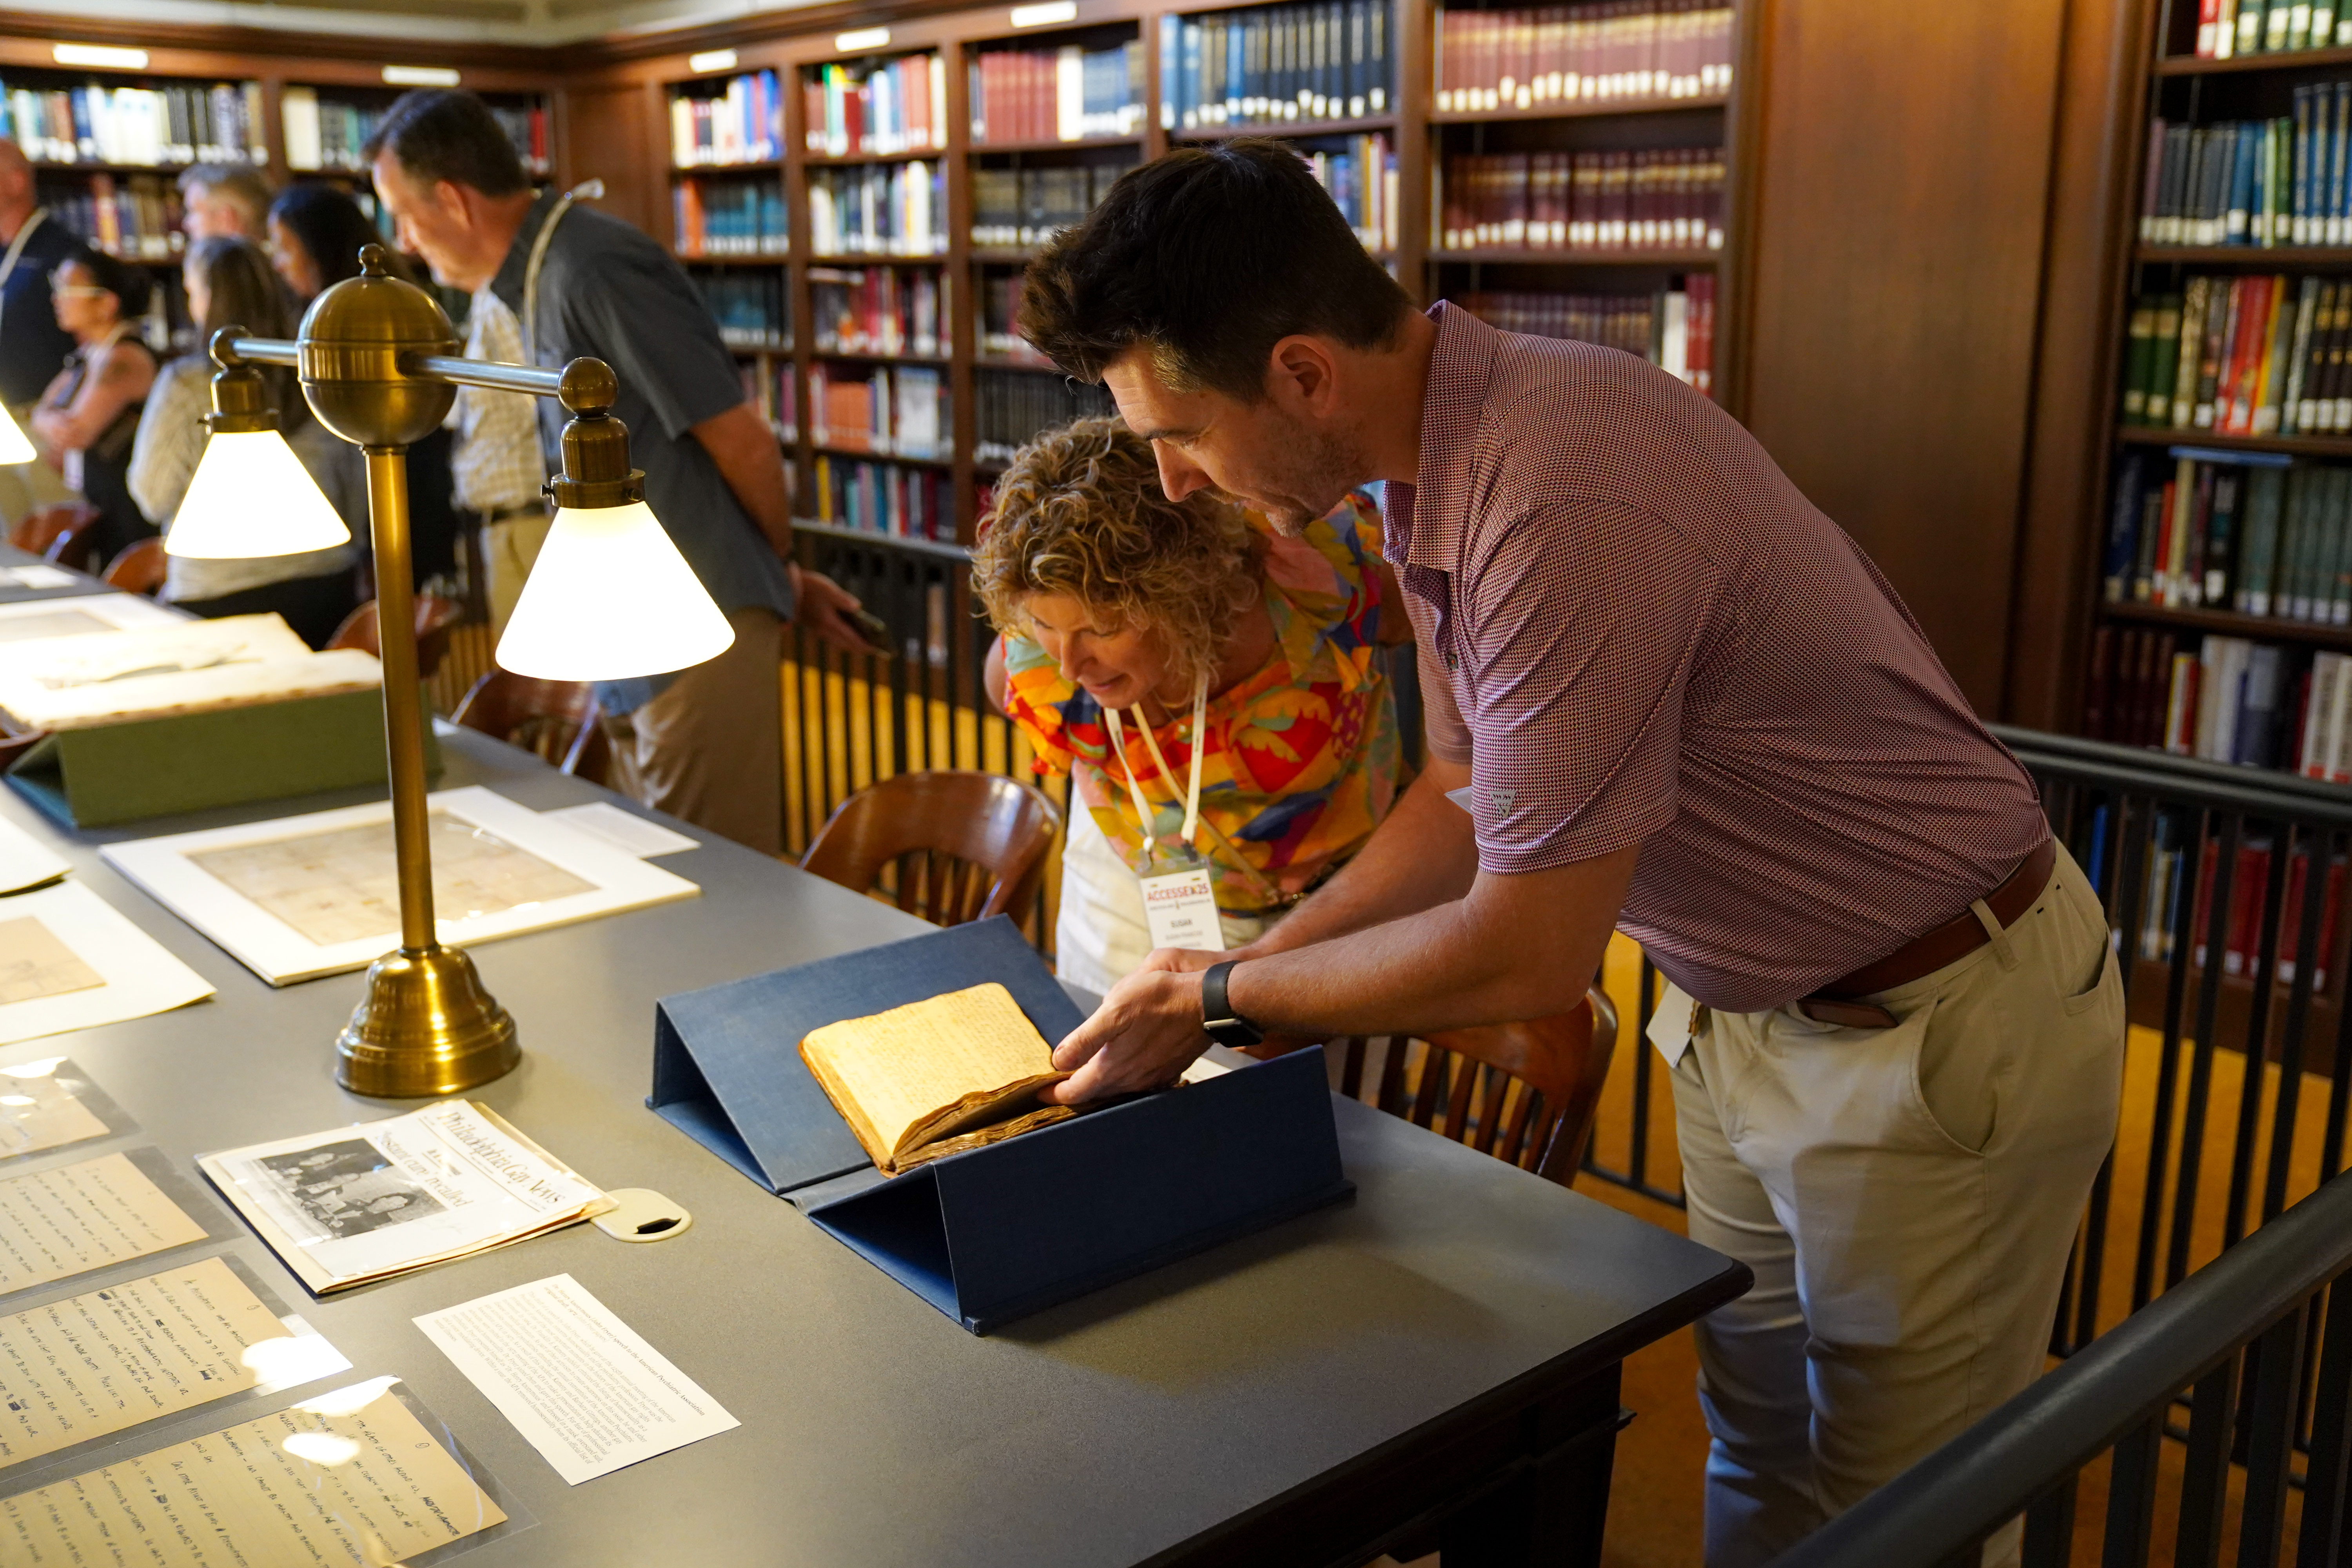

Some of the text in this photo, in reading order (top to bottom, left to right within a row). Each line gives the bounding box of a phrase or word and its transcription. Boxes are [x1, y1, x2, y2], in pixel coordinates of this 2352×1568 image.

[437, 1111, 512, 1169] Philadelphia
[502, 1163, 531, 1187] Gay
[527, 1179, 566, 1203] News
[424, 1177, 474, 1207] recalled
[229, 1330, 250, 1348] HOMOSEXUA
[612, 1337, 630, 1350] speech
[637, 1358, 661, 1376] American
[655, 1375, 683, 1396] Psychiatric
[678, 1394, 707, 1416] Association
[611, 1401, 641, 1425] homosexuality
[636, 1401, 652, 1411] Fryer
[656, 1406, 677, 1423] American
[595, 1408, 617, 1425] American
[611, 1424, 636, 1443] Psychiatric
[635, 1412, 652, 1423] rights
[552, 1427, 566, 1437] from
[565, 1440, 583, 1454] official
[573, 1422, 585, 1431] fear
[583, 1433, 610, 1455] professional
[581, 1420, 595, 1429] help
[590, 1427, 609, 1442] educate
[599, 1424, 618, 1438] another
[633, 1432, 648, 1443] other
[575, 1437, 597, 1455] oversized
